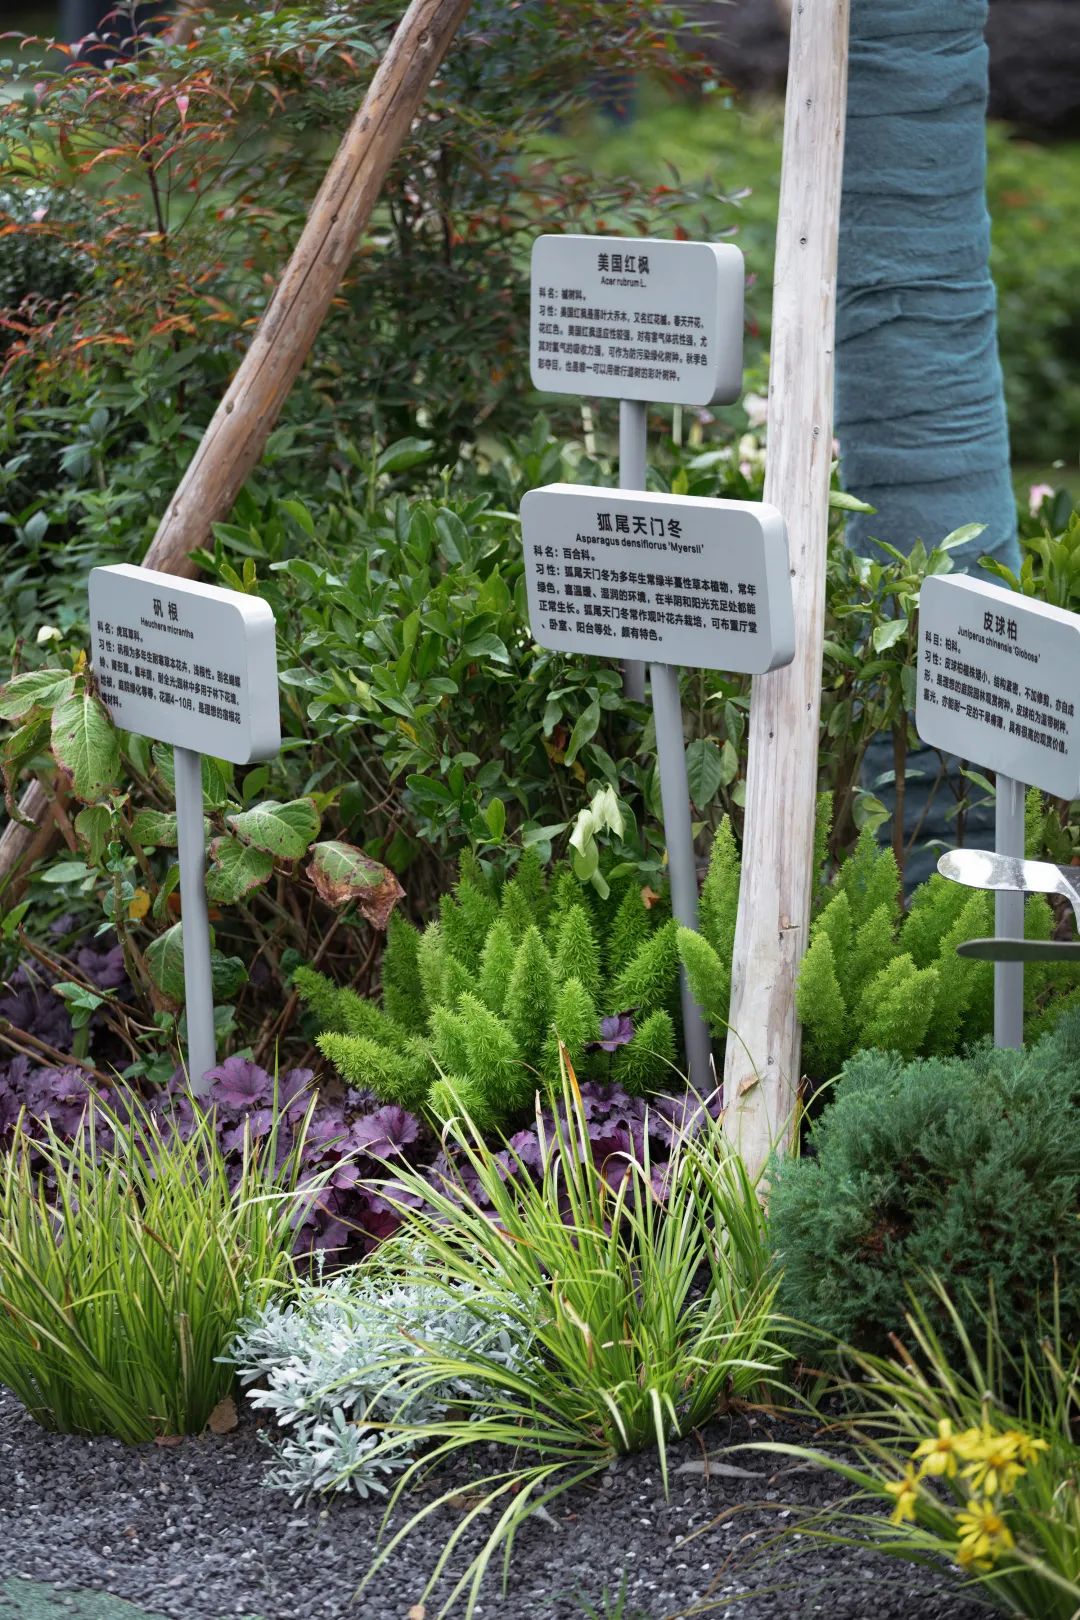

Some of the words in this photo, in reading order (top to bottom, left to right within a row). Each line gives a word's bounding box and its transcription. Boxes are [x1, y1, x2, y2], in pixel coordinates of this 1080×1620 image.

[598, 253, 650, 275] 美国红枫
[601, 276, 617, 286] Acer
[617, 277, 640, 287] rubrum
[640, 279, 646, 288] L.
[597, 513, 682, 539] 狐尾天门冬
[576, 533, 620, 547] Asparagus
[621, 537, 667, 550] densiflorus
[141, 617, 166, 632] Heuchera
[167, 625, 194, 639] micrantha
[983, 611, 1017, 641] 皮球柏
[957, 626, 986, 644] Juniperus
[986, 636, 1013, 654] chinensis
